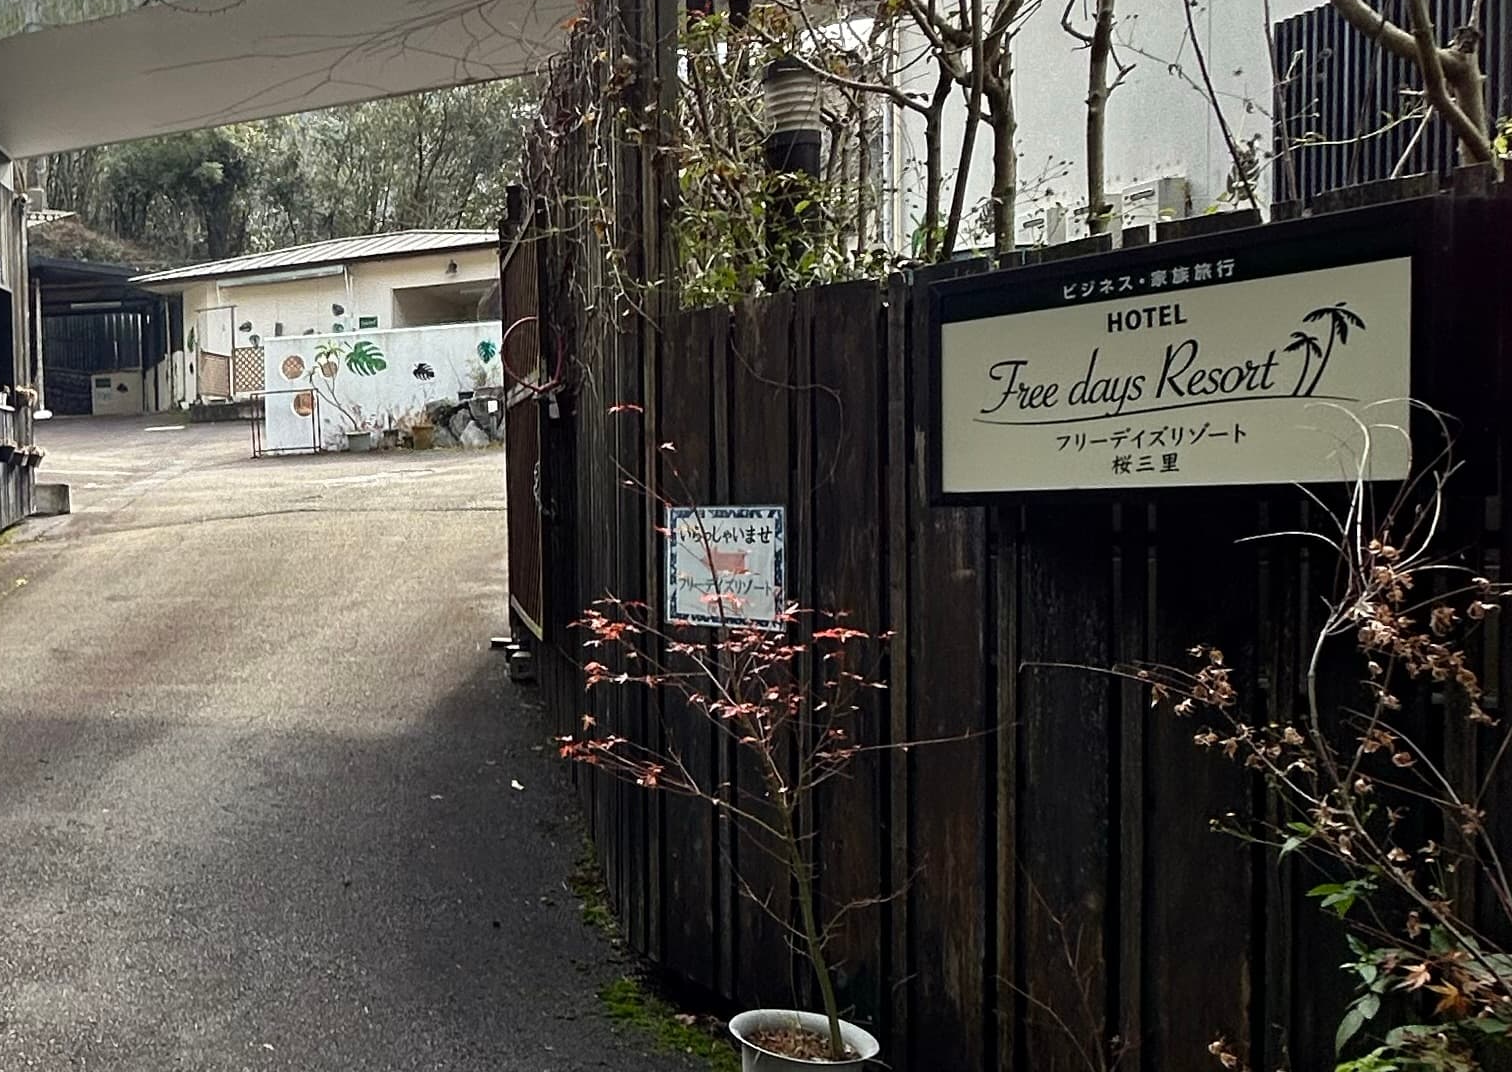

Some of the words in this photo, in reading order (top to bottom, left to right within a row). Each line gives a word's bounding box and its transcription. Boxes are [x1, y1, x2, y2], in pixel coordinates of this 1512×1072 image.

[1063, 258, 1236, 300] ビジネス・家族旅行
[1107, 304, 1188, 333] HOTEL
[980, 359, 1059, 414] Free
[1068, 348, 1143, 416] days
[1156, 339, 1281, 399] Resort
[1056, 423, 1247, 452] フリーデイズリゾート
[1112, 453, 1179, 475] 桜三里
[680, 524, 773, 544] いらっしゃいませ
[678, 576, 773, 596] フリーデイズリゾート
